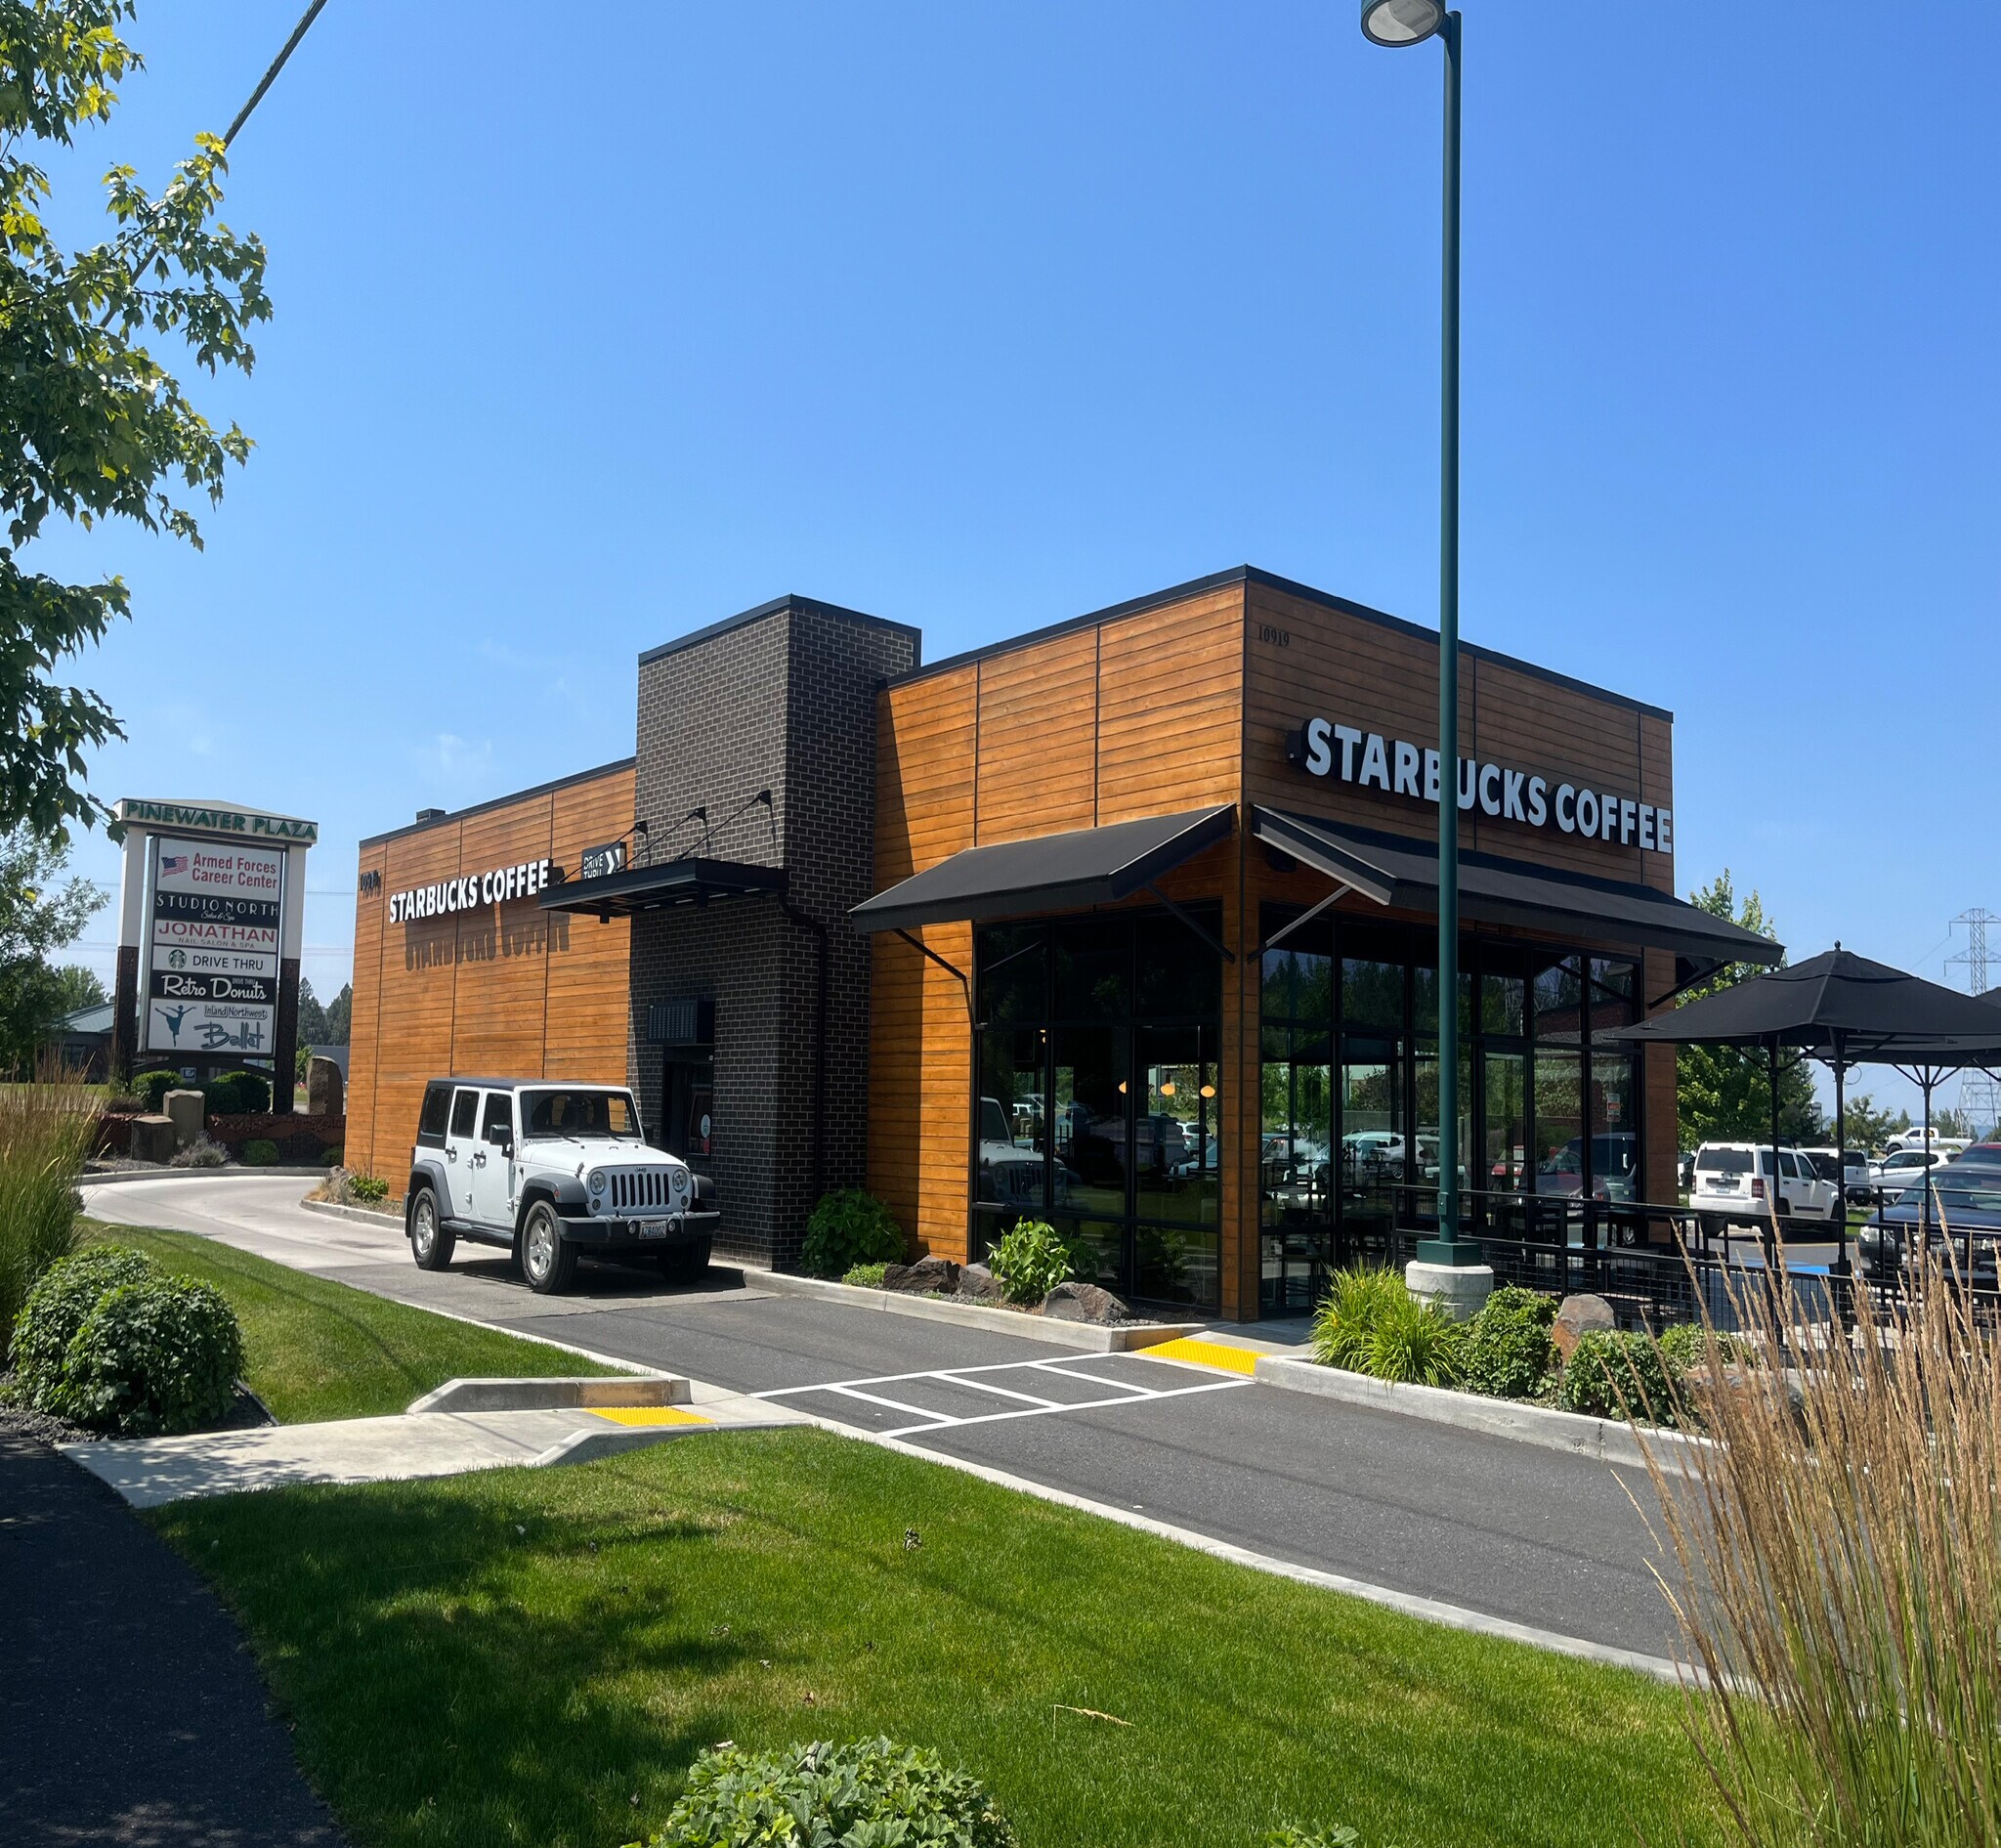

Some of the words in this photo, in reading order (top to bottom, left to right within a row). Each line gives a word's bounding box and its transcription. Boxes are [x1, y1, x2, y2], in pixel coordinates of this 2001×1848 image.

[1258, 624, 1290, 647] 10919
[1304, 716, 1548, 827] STARBUCKS
[1554, 782, 1673, 854] COFFEE
[125, 800, 245, 832] PINEWATER
[251, 815, 317, 840] PLAZA
[192, 852, 233, 870] Armed
[236, 857, 277, 875] Forces
[583, 853, 604, 870] DRIVE
[192, 867, 234, 885] Career
[237, 872, 277, 889] Center
[389, 876, 479, 924] STARBUCKS
[481, 858, 550, 905] COFFEE
[156, 893, 220, 913] STUDIO
[225, 900, 278, 918] NORTH
[158, 922, 276, 943] JONATHAN
[192, 955, 229, 968] DRIVE
[234, 958, 264, 971] THRU
[160, 973, 207, 998] Retro
[209, 976, 267, 1000] Donuts
[204, 1005, 227, 1017] Inland
[229, 1007, 268, 1019] Northwest
[193, 1021, 265, 1051] Ballet
